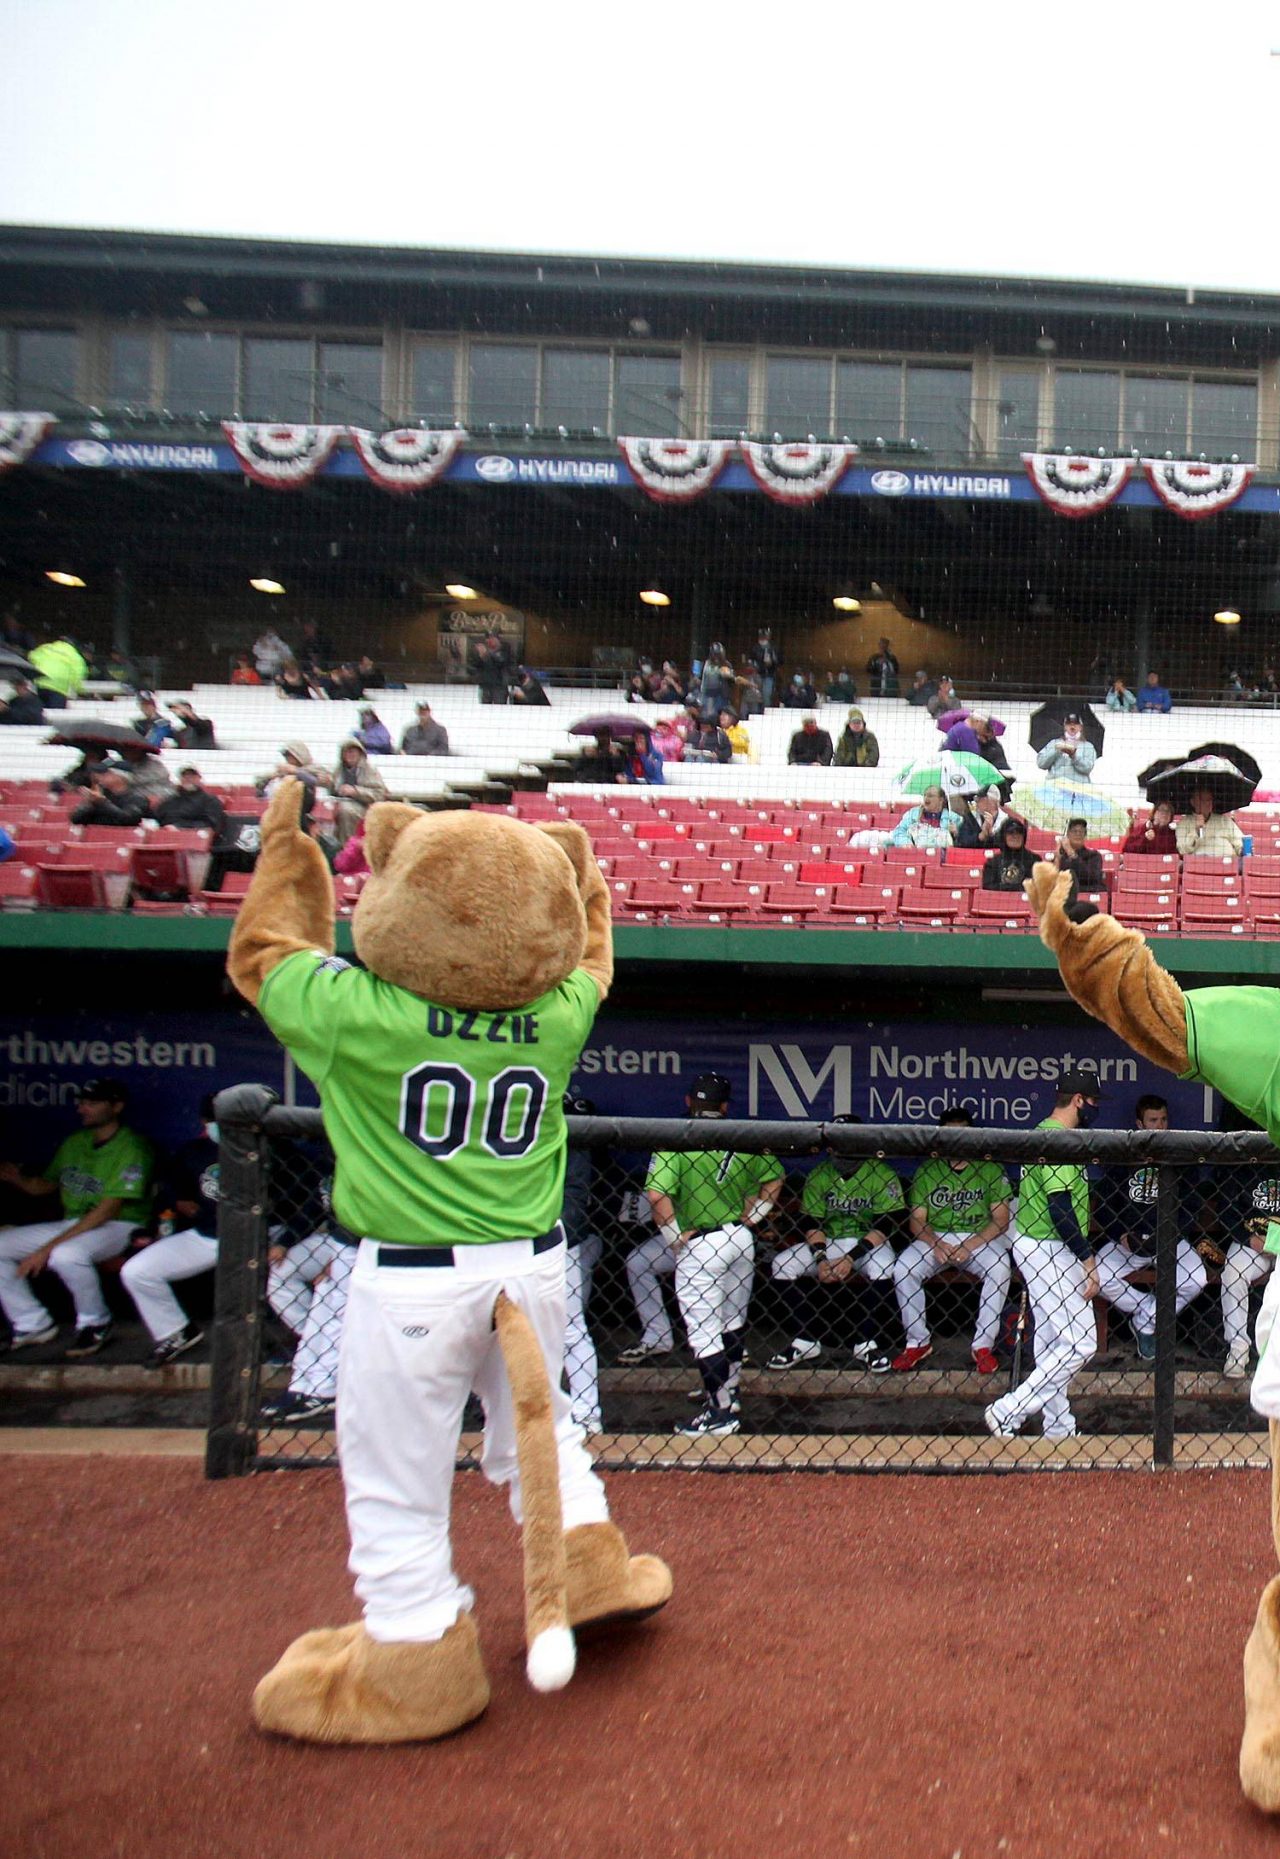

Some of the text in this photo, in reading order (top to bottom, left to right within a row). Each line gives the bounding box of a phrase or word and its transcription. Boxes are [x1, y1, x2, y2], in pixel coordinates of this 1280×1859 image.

[111, 442, 218, 469] HYUNDAI
[518, 458, 617, 483] HYUNDAI
[913, 473, 1010, 497] HYUNDAI
[427, 1004, 539, 1044] OZZIE
[573, 1044, 681, 1075] stern
[869, 1045, 1138, 1082] Northwestern
[399, 1060, 549, 1160] 00
[869, 1087, 1031, 1121] Medicine
